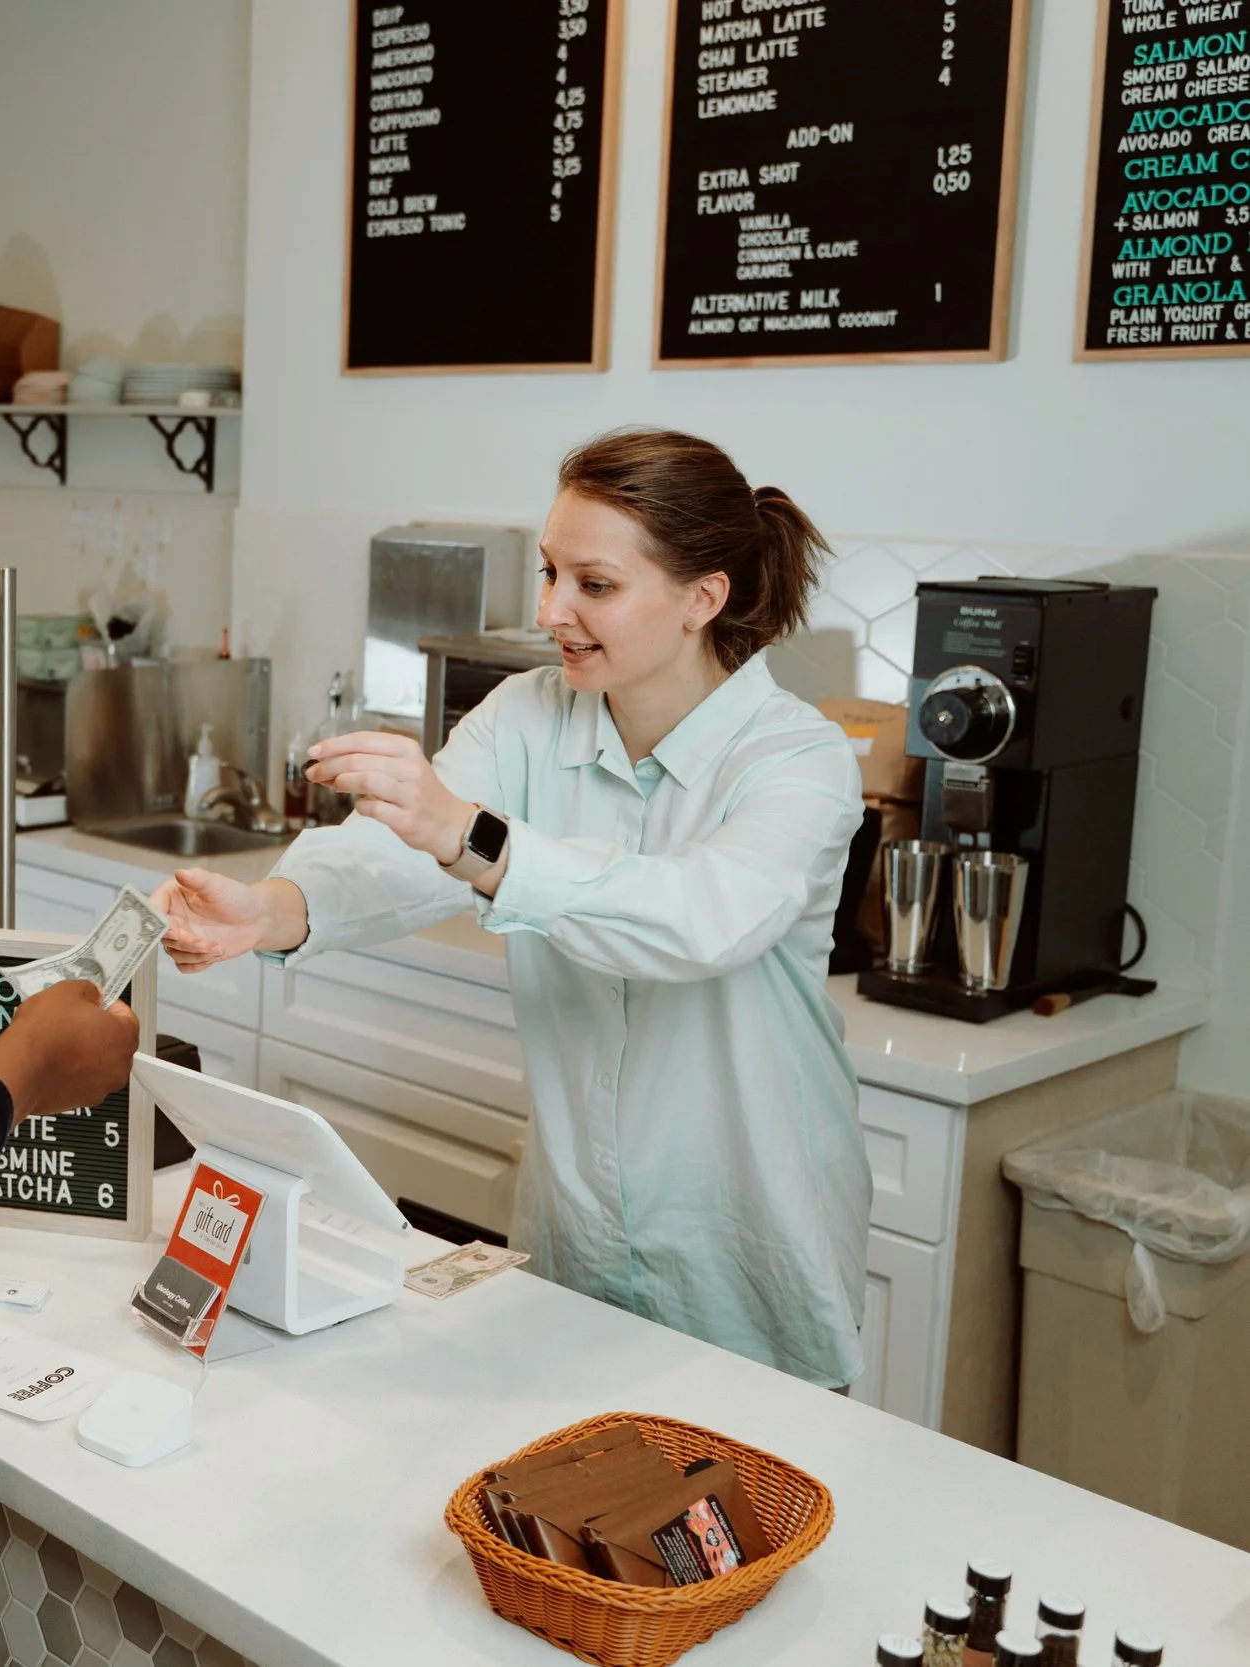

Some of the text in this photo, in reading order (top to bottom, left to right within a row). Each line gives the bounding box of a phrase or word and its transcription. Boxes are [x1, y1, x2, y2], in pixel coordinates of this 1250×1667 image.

[701, 0, 734, 21] HOT
[1121, 1, 1243, 35] WHOLE WHEAT
[1123, 0, 1165, 15] TUNA
[558, 17, 588, 40] 3,50
[700, 18, 762, 45] MATCHA
[773, 6, 827, 34] LATTE
[942, 11, 956, 33] 5
[372, 22, 430, 48] ESPRESSO
[557, 43, 568, 62] 4
[698, 36, 799, 70] CHAI LATTE
[941, 39, 955, 60] 2
[1133, 30, 1248, 66] SALMON
[556, 66, 567, 84] 4
[697, 66, 769, 95] STEAMER
[938, 65, 952, 87] 4
[1122, 62, 1187, 87] SMOKED
[1121, 74, 1250, 105] CREAM CHEESE
[698, 90, 778, 119] LEMONADE
[1127, 99, 1250, 134] AVOCADO
[553, 110, 583, 132] 4,75
[370, 133, 408, 154] LATTE
[553, 134, 575, 156] 5,5
[786, 122, 854, 149] ADD-ON
[1117, 129, 1192, 153] AVOCADO
[369, 155, 410, 175] MOCHA
[937, 144, 972, 170] 1,25
[1124, 151, 1219, 181] CREAM
[698, 162, 801, 191] EXTRA SHOT
[933, 171, 971, 196] 0,50
[551, 181, 562, 199] 4
[1121, 182, 1250, 215] AVOCADO
[367, 194, 437, 216] COLD BREW
[550, 203, 561, 222] 5
[697, 192, 755, 215] FLAVOR
[366, 212, 466, 237] ESPRESSO TONIC
[739, 213, 791, 231] VANILLA
[738, 227, 810, 248] CHOCOLATE
[1117, 232, 1233, 260] ALMOND
[737, 240, 859, 264] CINNAMON & CLOVE
[736, 262, 793, 280] CARAMEL
[1111, 255, 1243, 279] WITH JELLY &
[691, 288, 841, 315] ALTERNATIVE MILK
[934, 282, 942, 302] 1
[1113, 279, 1247, 307] GRANOLA
[688, 317, 735, 335] ALMOND
[838, 310, 899, 329] COCONUT
[1110, 307, 1157, 325] PLAIN
[1163, 304, 1225, 323] YOGURT
[1106, 325, 1163, 344] FRESH
[1171, 323, 1218, 341] FRUIT
[1225, 322, 1238, 339] &
[103, 1122, 120, 1148] 5
[97, 1183, 114, 1209] 6
[193, 1207, 214, 1233] gift
[212, 1219, 236, 1244] card
[156, 1282, 176, 1301] Ideology
[174, 1294, 191, 1309] Coffee
[6, 1366, 75, 1402] COFFEE
[711, 1501, 720, 1514] Raw
[717, 1513, 729, 1534] Vegan
[726, 1531, 742, 1560] Chocolate
